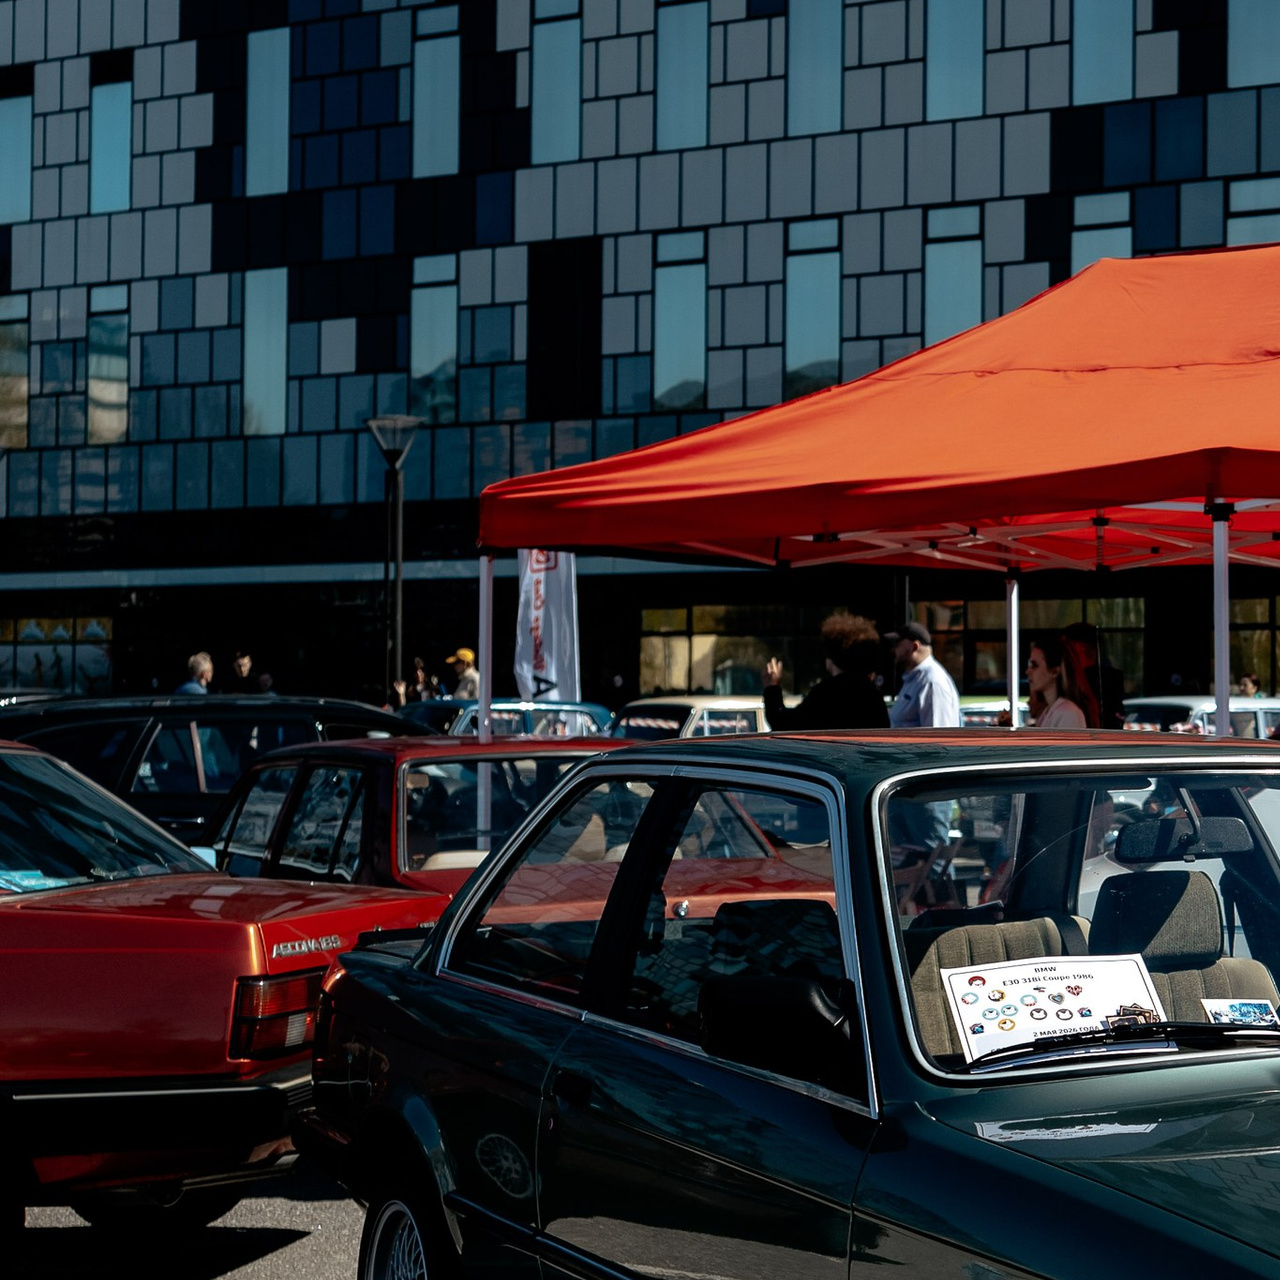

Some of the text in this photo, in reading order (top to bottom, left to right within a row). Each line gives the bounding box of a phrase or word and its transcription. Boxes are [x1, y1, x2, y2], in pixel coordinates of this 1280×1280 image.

[1002, 978, 1020, 987] E30
[1021, 976, 1042, 984] 318i
[1043, 974, 1071, 982] Coupe
[1040, 1029, 1058, 1037] МАЯ
[1059, 1027, 1078, 1035] 2026
